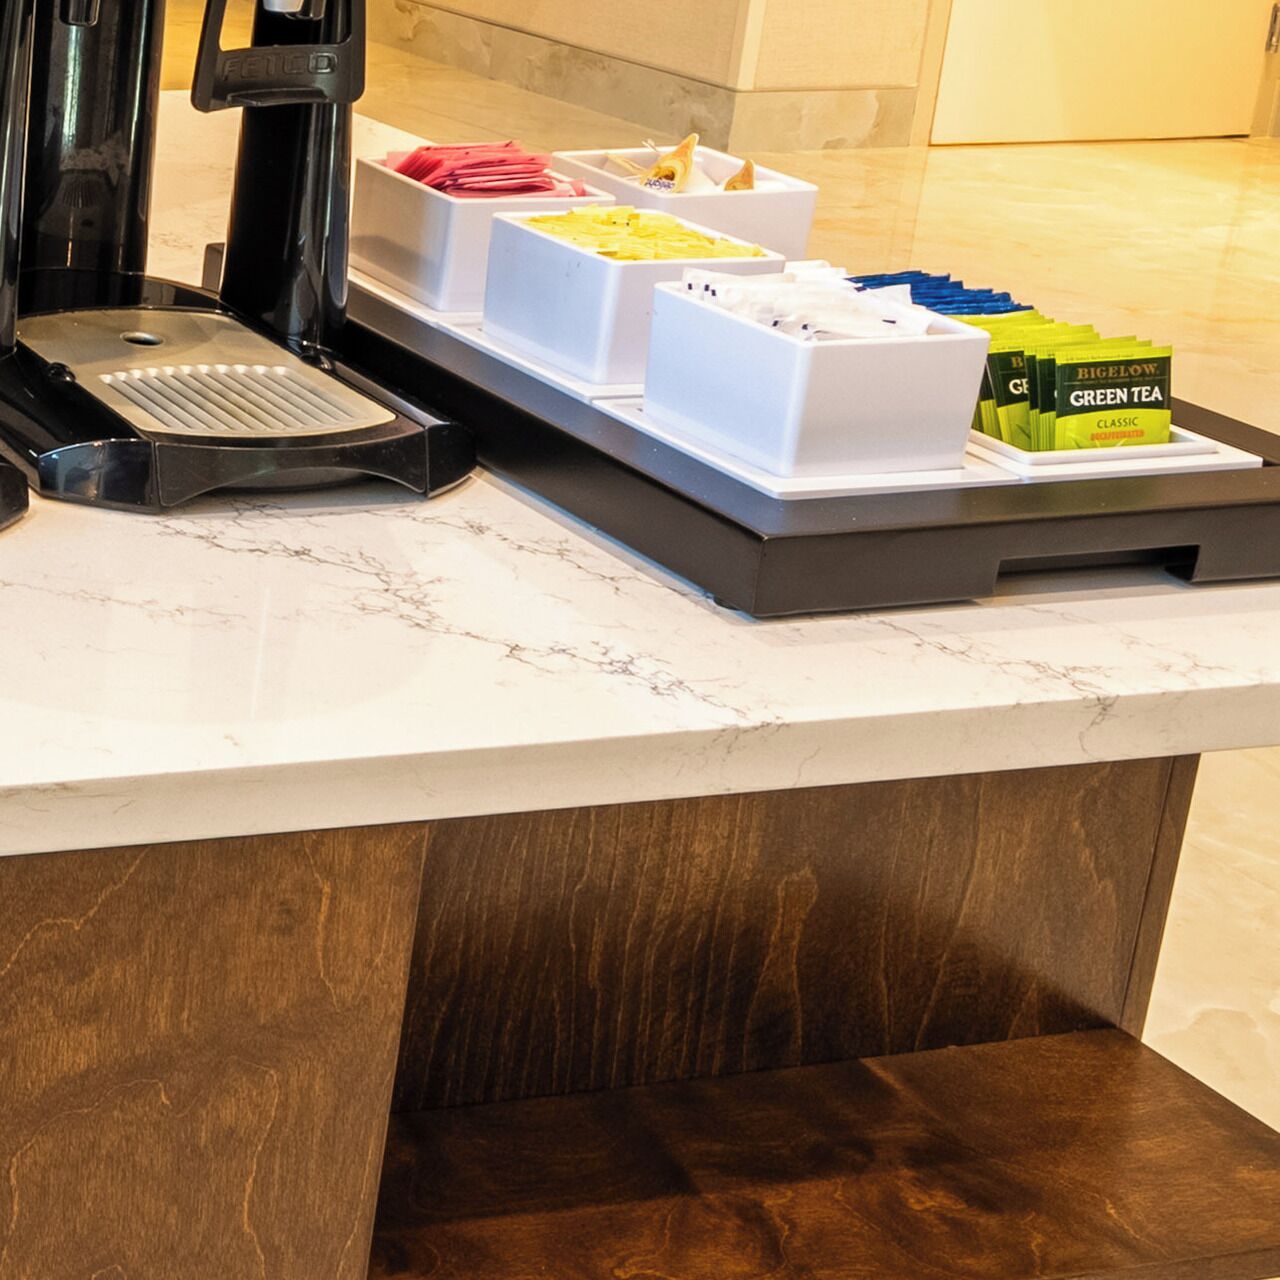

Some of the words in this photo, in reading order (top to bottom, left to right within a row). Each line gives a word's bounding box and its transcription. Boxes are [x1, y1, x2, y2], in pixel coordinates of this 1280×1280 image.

[1076, 363, 1158, 380] BIGELOW
[1069, 387, 1128, 407] GREEN
[1131, 385, 1163, 403] TEA
[1097, 417, 1138, 429] CLASSIC
